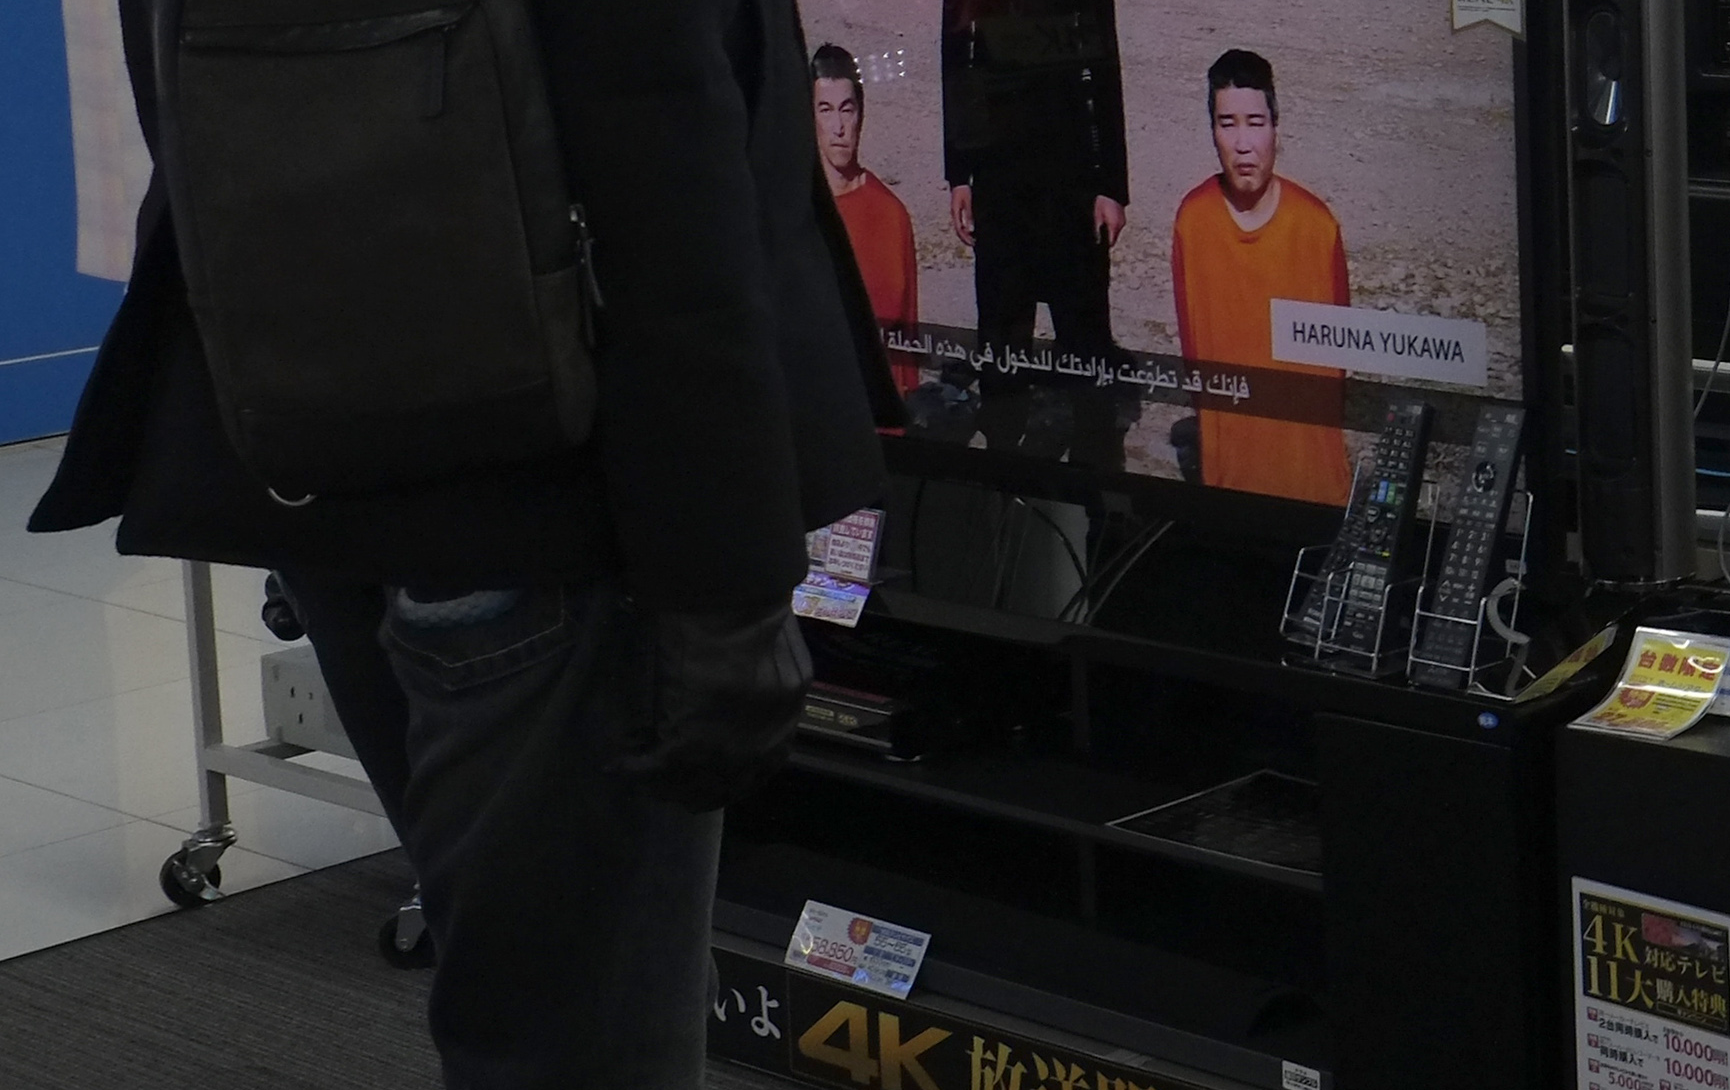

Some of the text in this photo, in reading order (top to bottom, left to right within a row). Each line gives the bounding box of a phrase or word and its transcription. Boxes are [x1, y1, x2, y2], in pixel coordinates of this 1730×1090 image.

[886, 329, 932, 355] الحملة
[935, 337, 966, 361] هذه
[969, 339, 995, 369] في
[1292, 320, 1465, 363] HARUNA YUKAWA
[999, 342, 1052, 374] للدخول
[1055, 351, 1115, 388] بإرادتك
[1181, 371, 1202, 394] قد
[1205, 373, 1250, 406] فإنك
[799, 1000, 952, 1090] 4K
